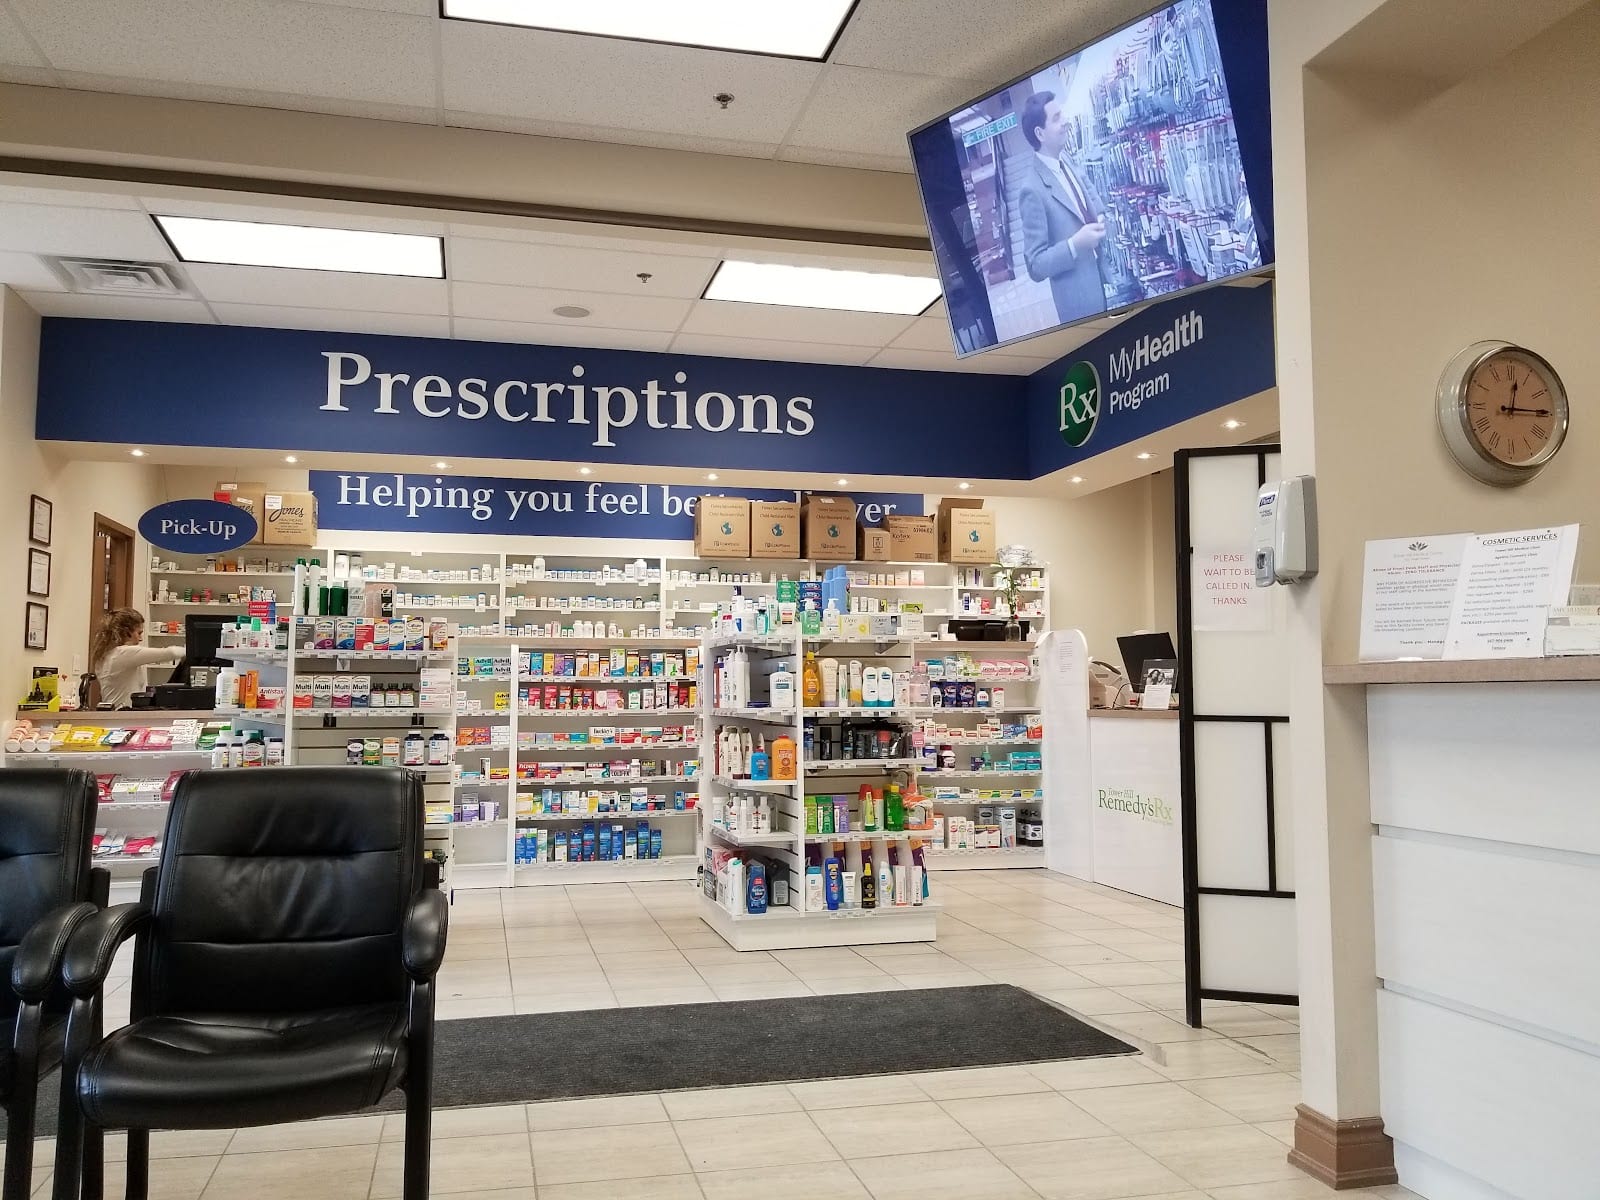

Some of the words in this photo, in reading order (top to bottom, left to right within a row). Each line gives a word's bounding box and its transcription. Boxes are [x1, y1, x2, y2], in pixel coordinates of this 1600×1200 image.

[976, 125, 995, 140] FIRE
[996, 115, 1016, 131] EXIT
[1108, 310, 1204, 384] MyHealth
[319, 350, 816, 448] Prescriptions
[1109, 372, 1171, 415] Program
[1059, 382, 1097, 432] Rx
[337, 474, 496, 521] Helping
[504, 489, 575, 522] you
[584, 483, 651, 515] feel
[159, 518, 237, 541] Pick-Up
[1482, 538, 1522, 546] COSMETIC
[1522, 533, 1558, 542] SERVICES
[1213, 554, 1245, 562] PLEASE
[1203, 568, 1228, 576] WAIT
[1229, 568, 1242, 576] TO
[1244, 568, 1256, 576] BE
[1206, 582, 1239, 590] CALLED
[1240, 582, 1253, 590] IN.
[1211, 597, 1248, 605] THANKS
[1098, 789, 1173, 820] Remedy'sRx
[1108, 788, 1123, 798] Tower
[1124, 789, 1134, 799] Hill
